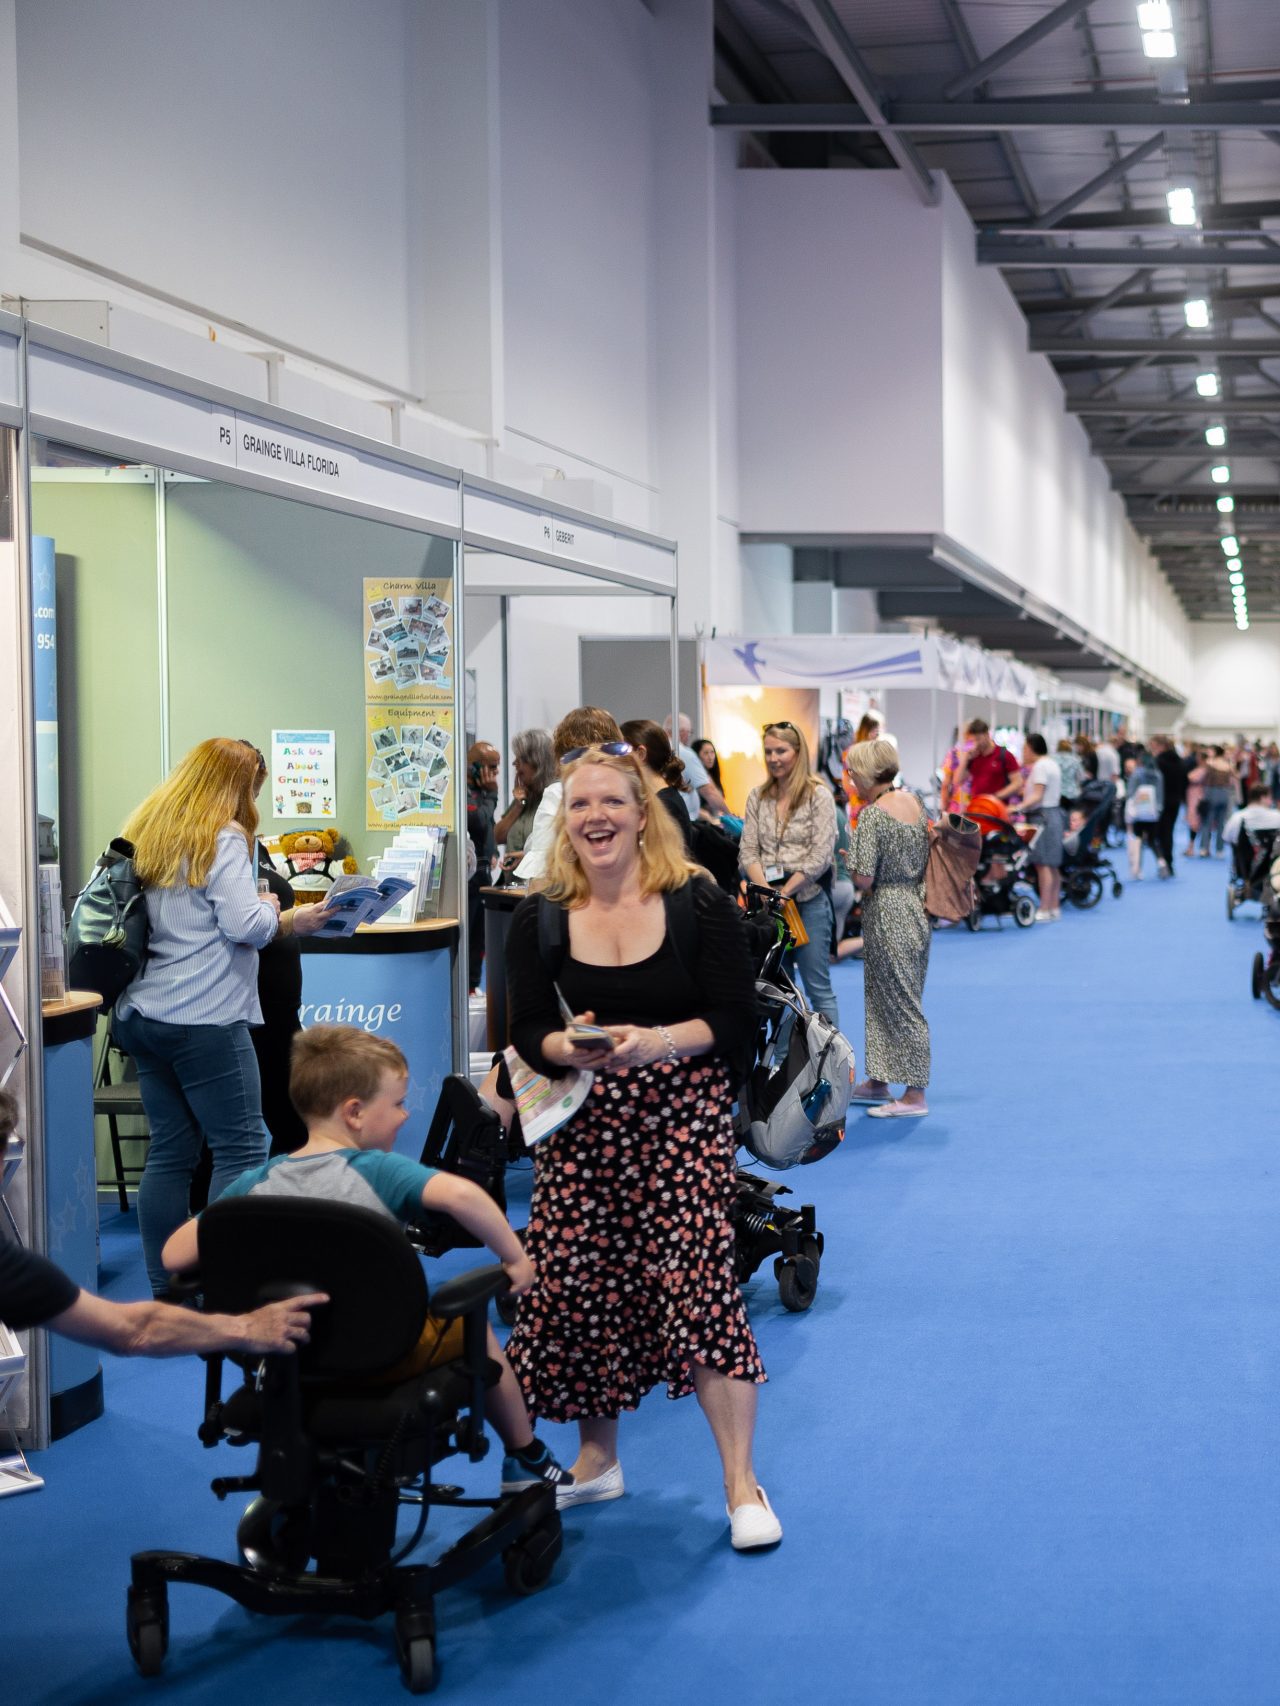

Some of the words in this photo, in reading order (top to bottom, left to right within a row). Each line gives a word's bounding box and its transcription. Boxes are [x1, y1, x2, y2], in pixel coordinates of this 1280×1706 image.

[219, 426, 231, 445] P5
[243, 433, 282, 461] GRAINGE
[283, 446, 305, 468] VILLA
[307, 454, 340, 477] FLORIDA
[383, 582, 412, 590] Charm
[387, 708, 436, 719] Equipment
[283, 747, 305, 756] Ask
[308, 747, 323, 756] Us
[286, 762, 320, 770] About
[278, 775, 329, 787] Graingey
[290, 789, 316, 798] Bear
[298, 997, 402, 1033] rainge
